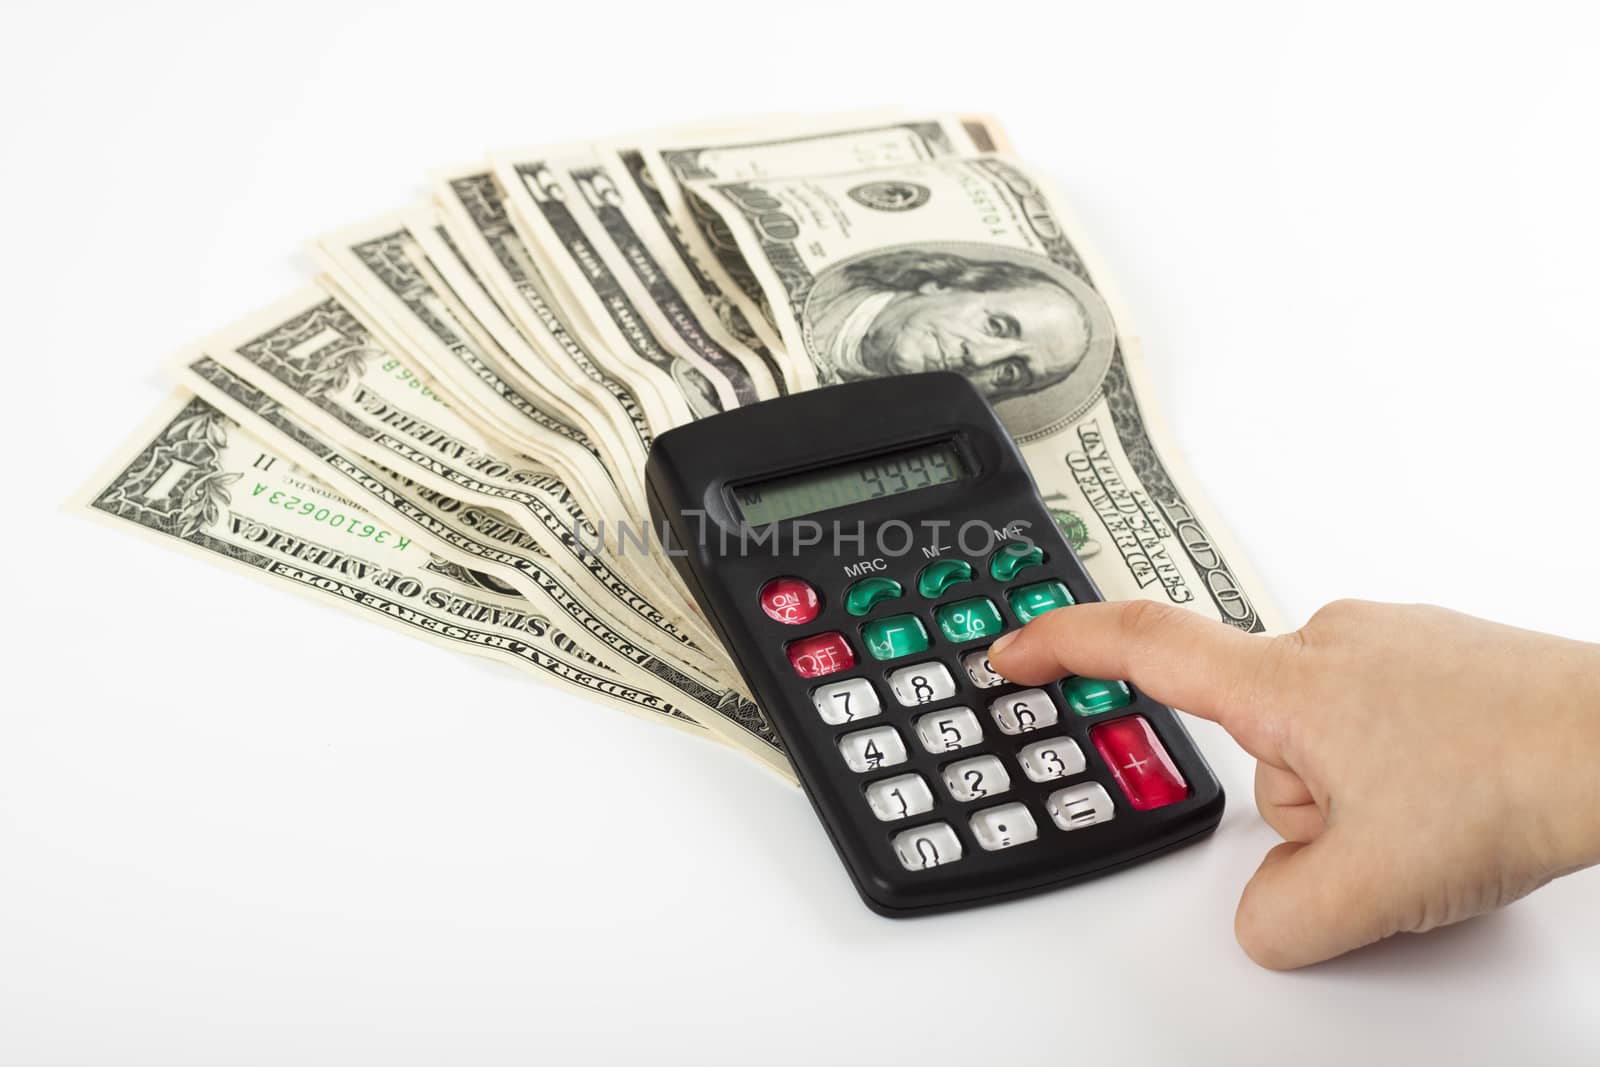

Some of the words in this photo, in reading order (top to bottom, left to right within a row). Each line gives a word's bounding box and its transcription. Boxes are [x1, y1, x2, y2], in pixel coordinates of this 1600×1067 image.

[227, 511, 378, 576] AMERICA
[269, 560, 363, 602] NOTE
[844, 557, 888, 579] MRC
[833, 691, 855, 724] 7
